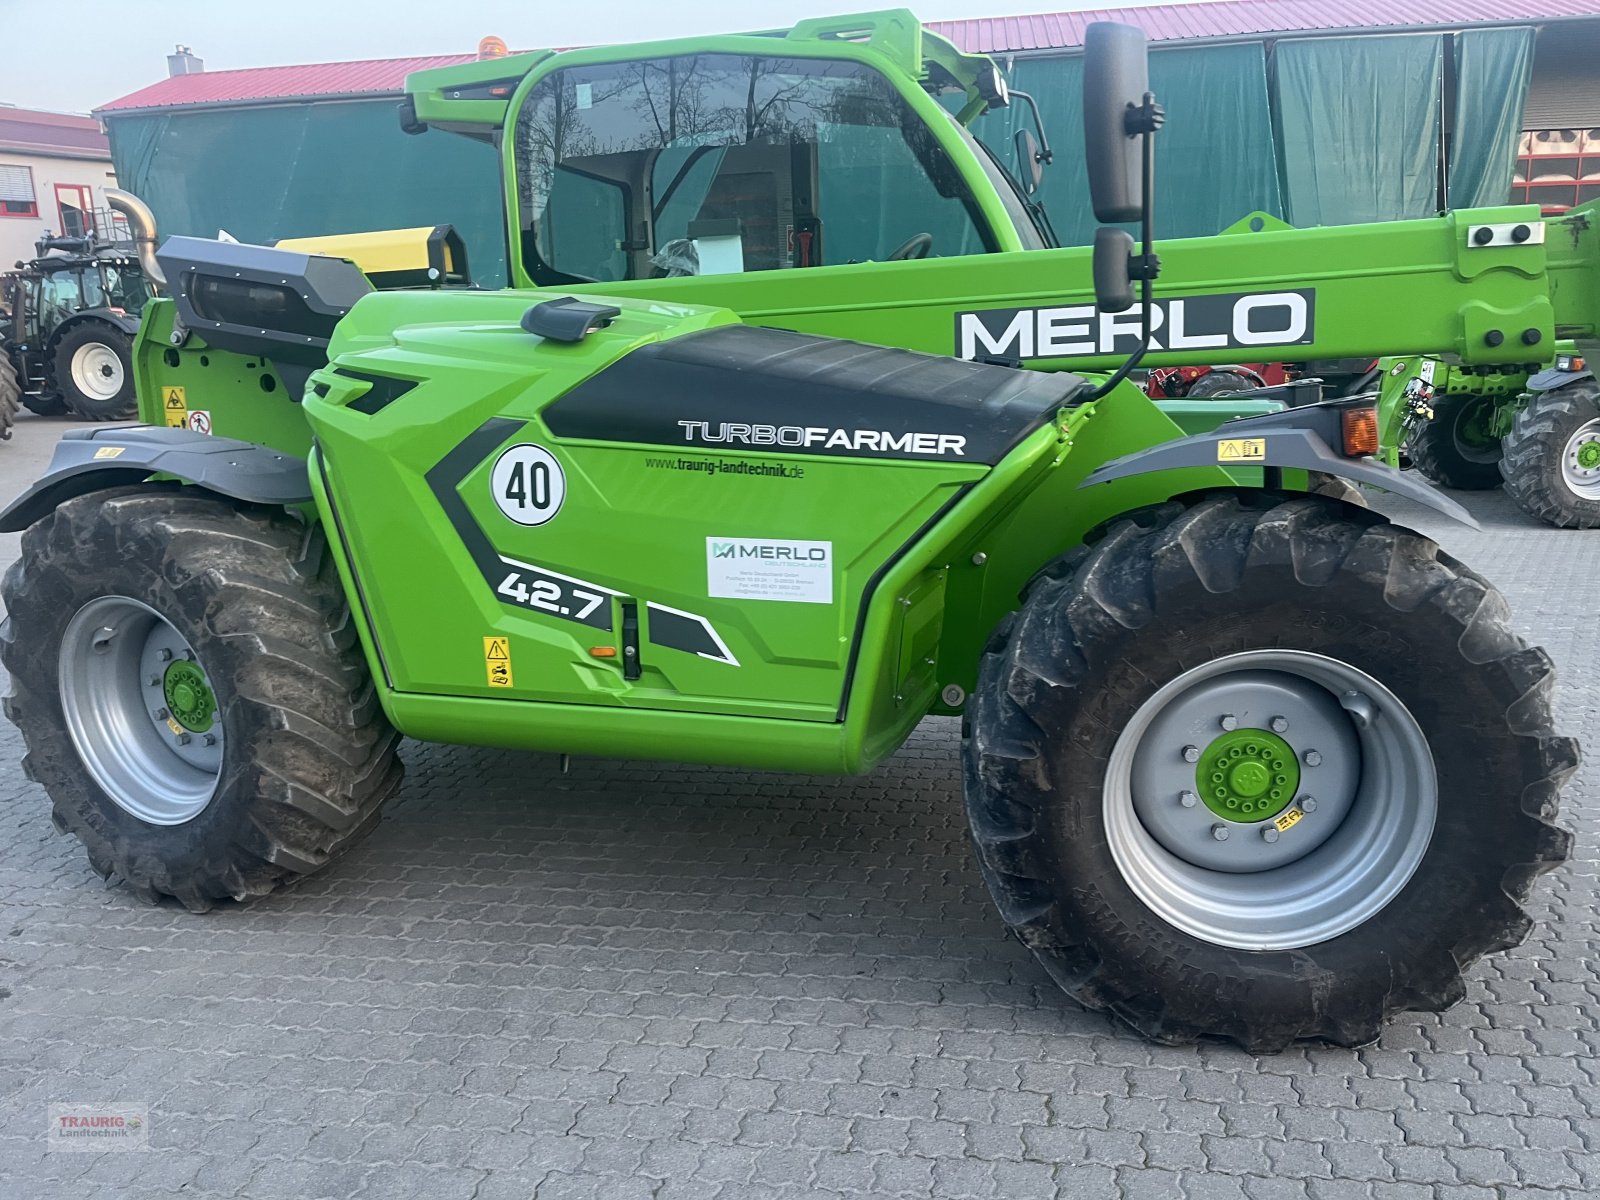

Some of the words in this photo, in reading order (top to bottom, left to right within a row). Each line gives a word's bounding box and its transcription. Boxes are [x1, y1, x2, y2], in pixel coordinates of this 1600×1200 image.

[960, 292, 1308, 360] MERLO
[677, 420, 966, 456] TURBOFARMER
[505, 461, 551, 510] 40
[645, 458, 804, 479] www.traurig-landtechnik.de
[739, 545, 826, 561] MERLO
[497, 572, 604, 620] 42.7
